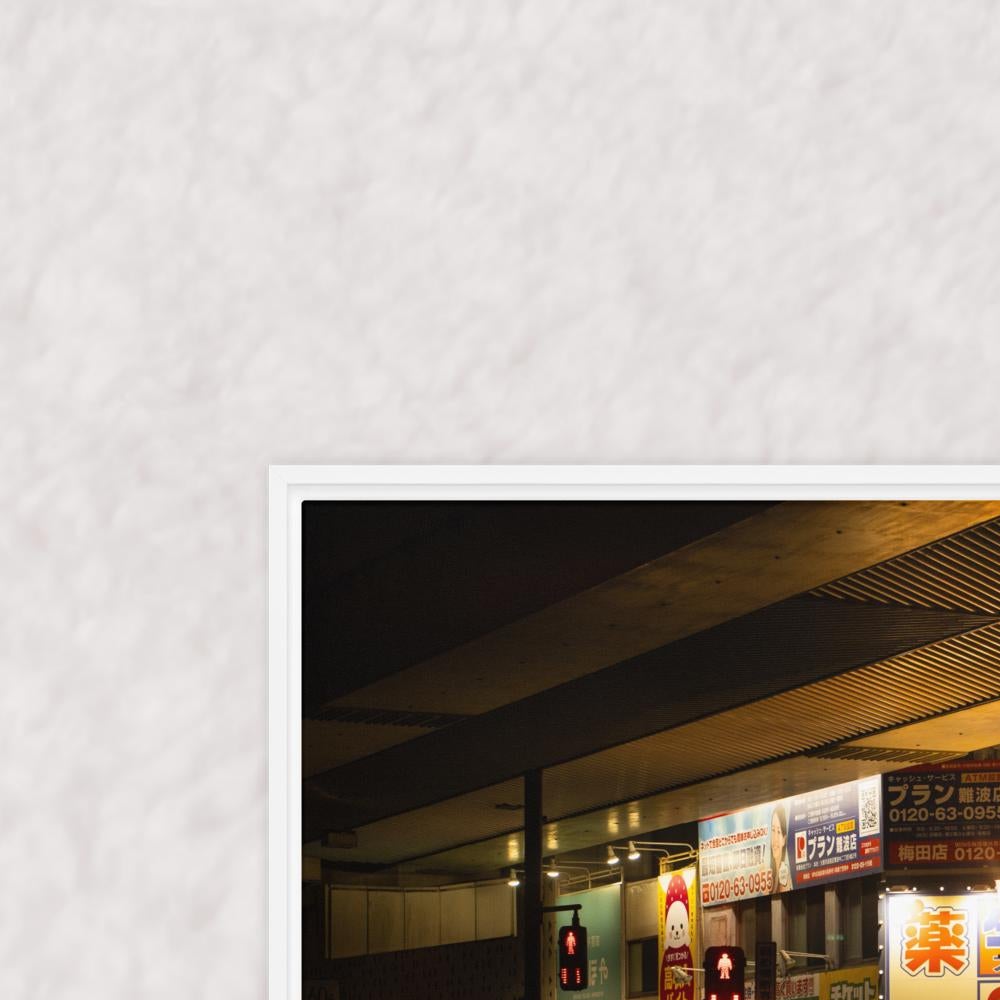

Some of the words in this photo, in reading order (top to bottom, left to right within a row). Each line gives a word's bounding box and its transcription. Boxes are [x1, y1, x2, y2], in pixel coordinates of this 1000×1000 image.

[887, 784, 955, 806] プラン
[808, 835, 835, 860] プラン
[898, 844, 949, 862] 梅田店
[903, 909, 966, 975] 薬
